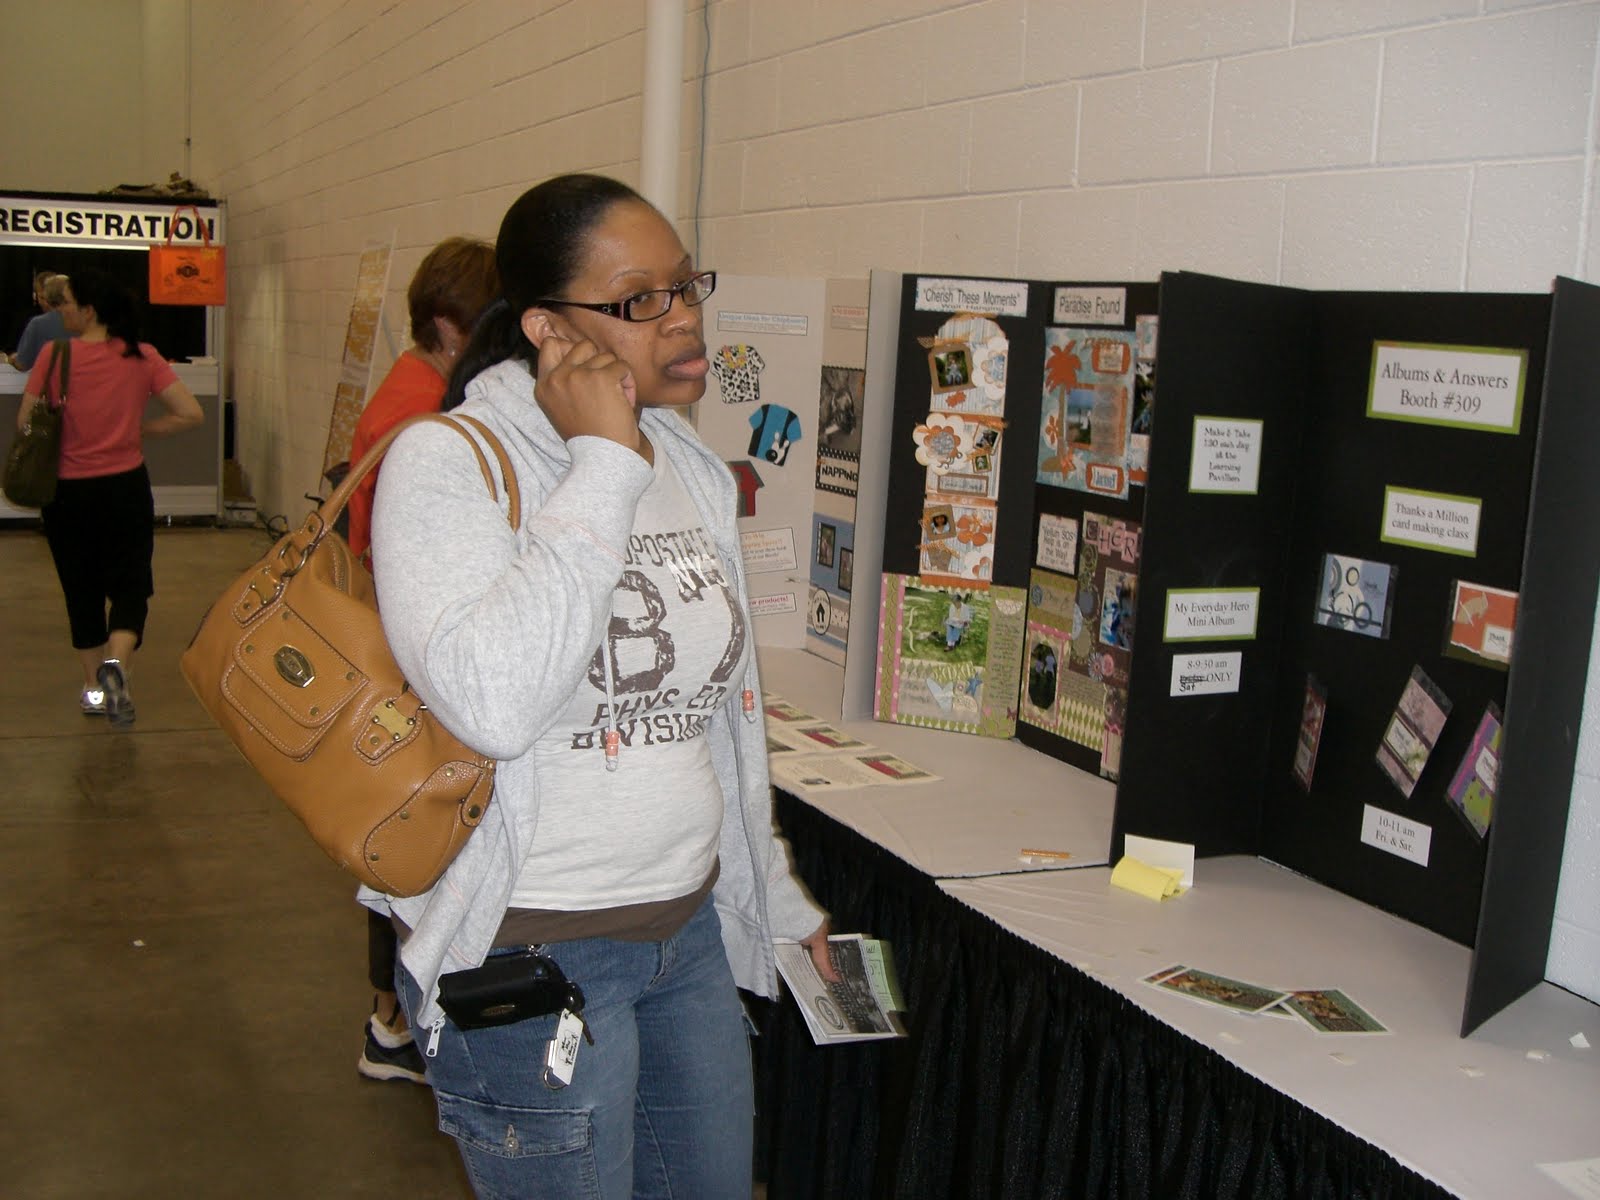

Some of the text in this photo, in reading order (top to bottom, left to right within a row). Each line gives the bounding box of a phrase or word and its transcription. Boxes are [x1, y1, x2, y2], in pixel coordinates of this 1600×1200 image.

[0, 207, 215, 240] REGISTRATION
[958, 290, 980, 305] These
[1059, 296, 1120, 315] Paradise Found
[1381, 362, 1509, 389] Albums & Answers
[1400, 388, 1482, 414] Booth #309
[821, 465, 858, 482] NAPPING
[1395, 502, 1469, 525] Thanks a Million
[1391, 519, 1469, 540] card making class
[1175, 601, 1250, 615] My Everyday Hero
[1188, 616, 1235, 627] Mini Album
[1215, 660, 1228, 668] am
[1206, 672, 1232, 683] ONLY
[1379, 815, 1415, 838] 10-11 am
[1390, 837, 1397, 848] &
